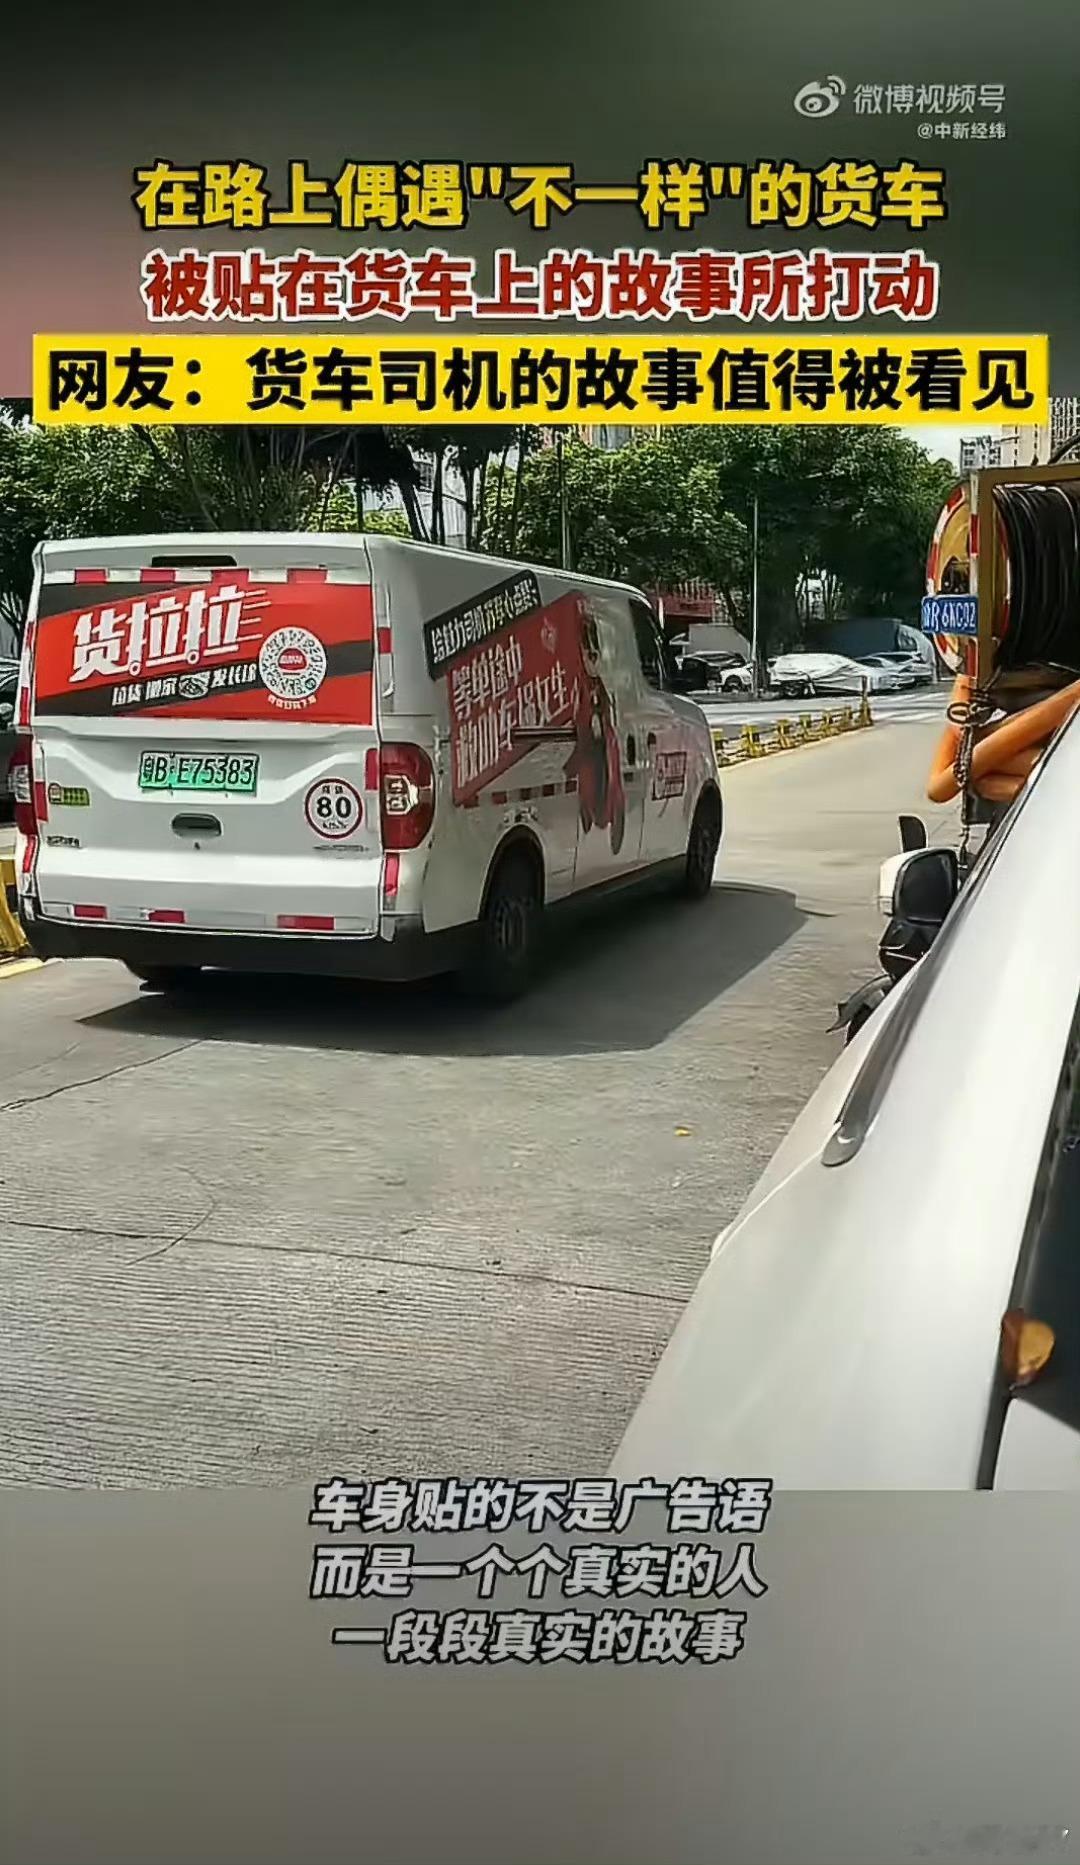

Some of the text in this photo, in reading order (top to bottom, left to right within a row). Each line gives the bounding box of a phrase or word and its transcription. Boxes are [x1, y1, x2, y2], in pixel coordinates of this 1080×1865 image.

[69, 585, 246, 682] 货拉拉
[317, 796, 352, 818] 80
